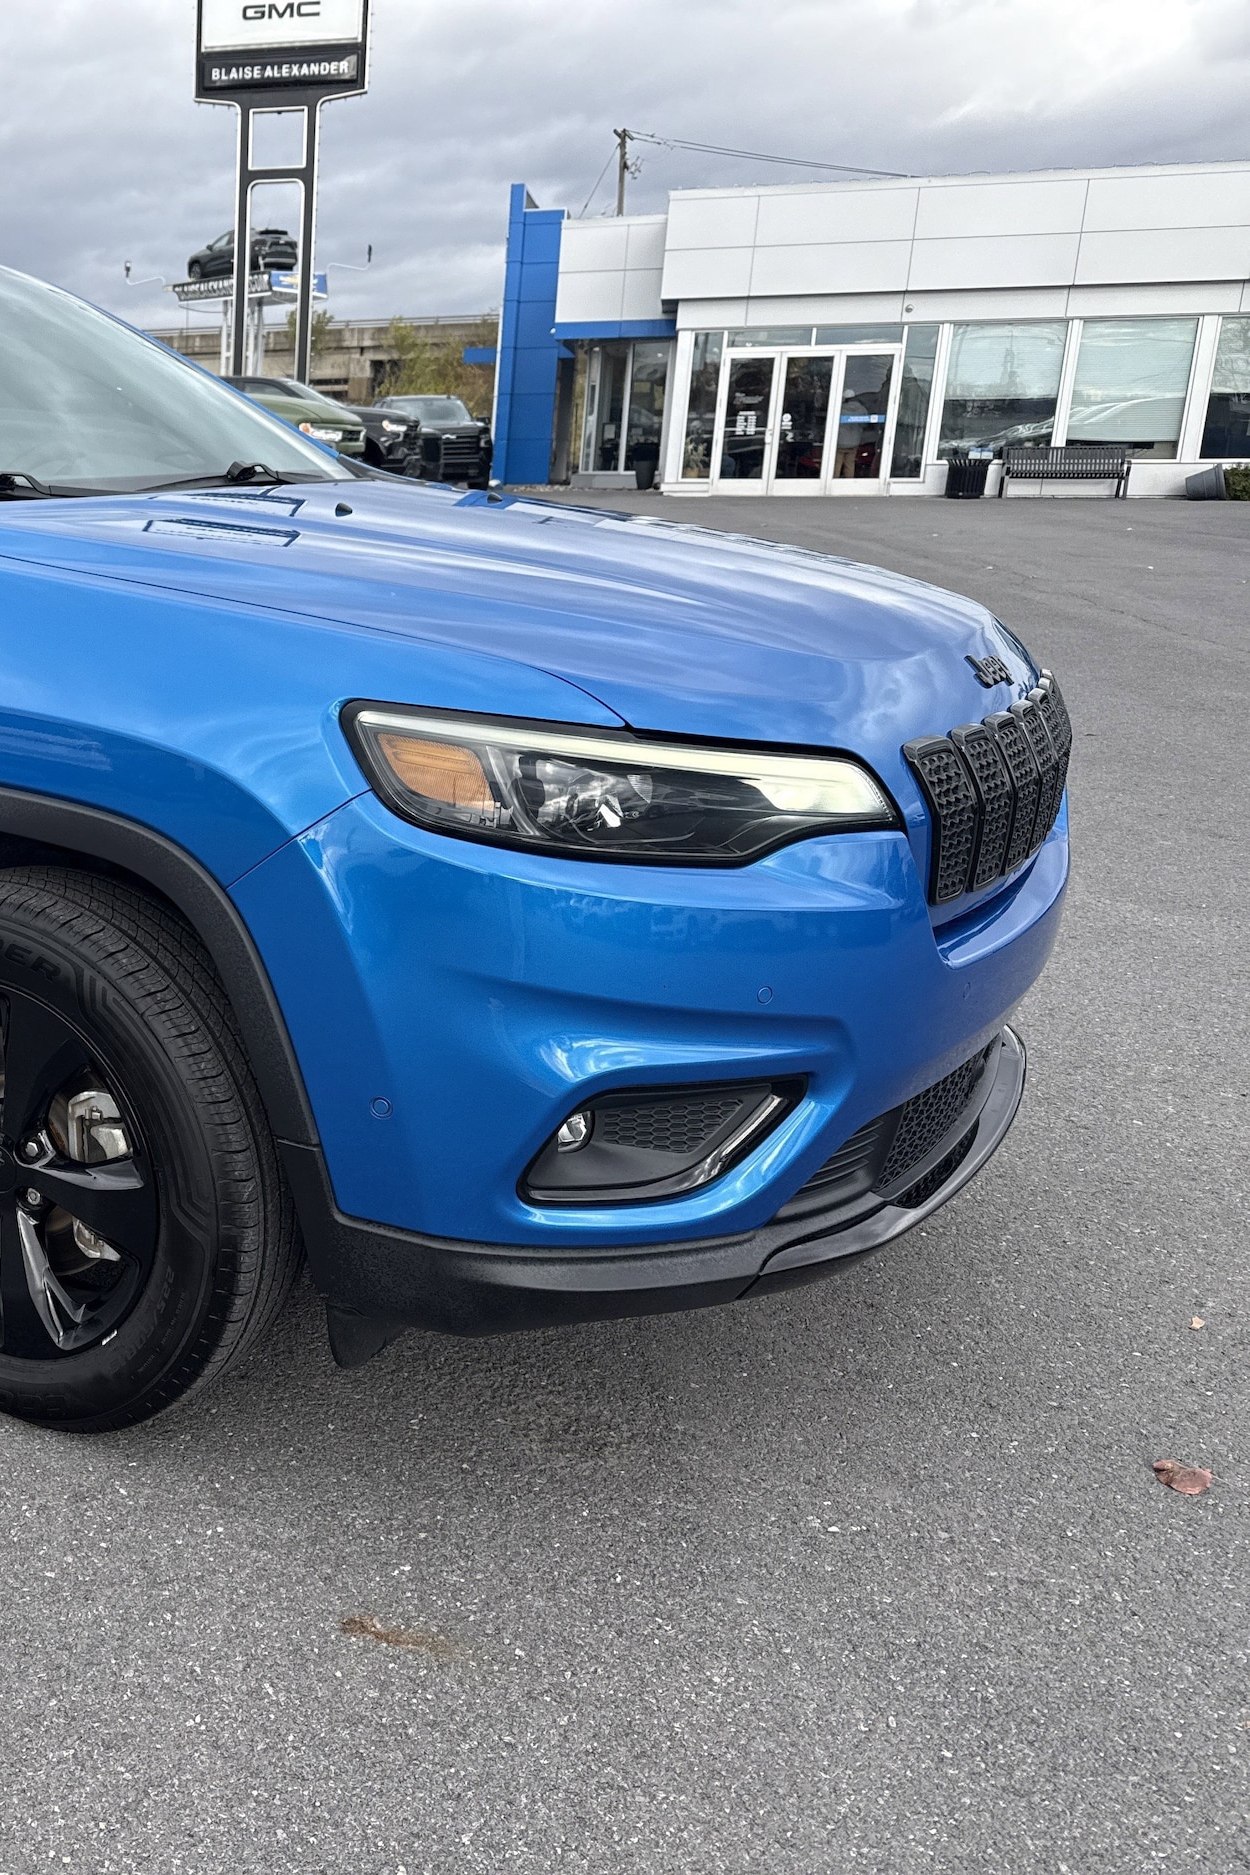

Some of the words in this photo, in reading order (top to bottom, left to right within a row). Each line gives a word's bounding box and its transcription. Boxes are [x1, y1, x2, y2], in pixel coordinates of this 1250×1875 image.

[242, 1, 321, 21] GMC
[211, 66, 262, 81] BLAISE
[264, 61, 349, 78] ALEXANDER
[963, 655, 1015, 689] Jeep
